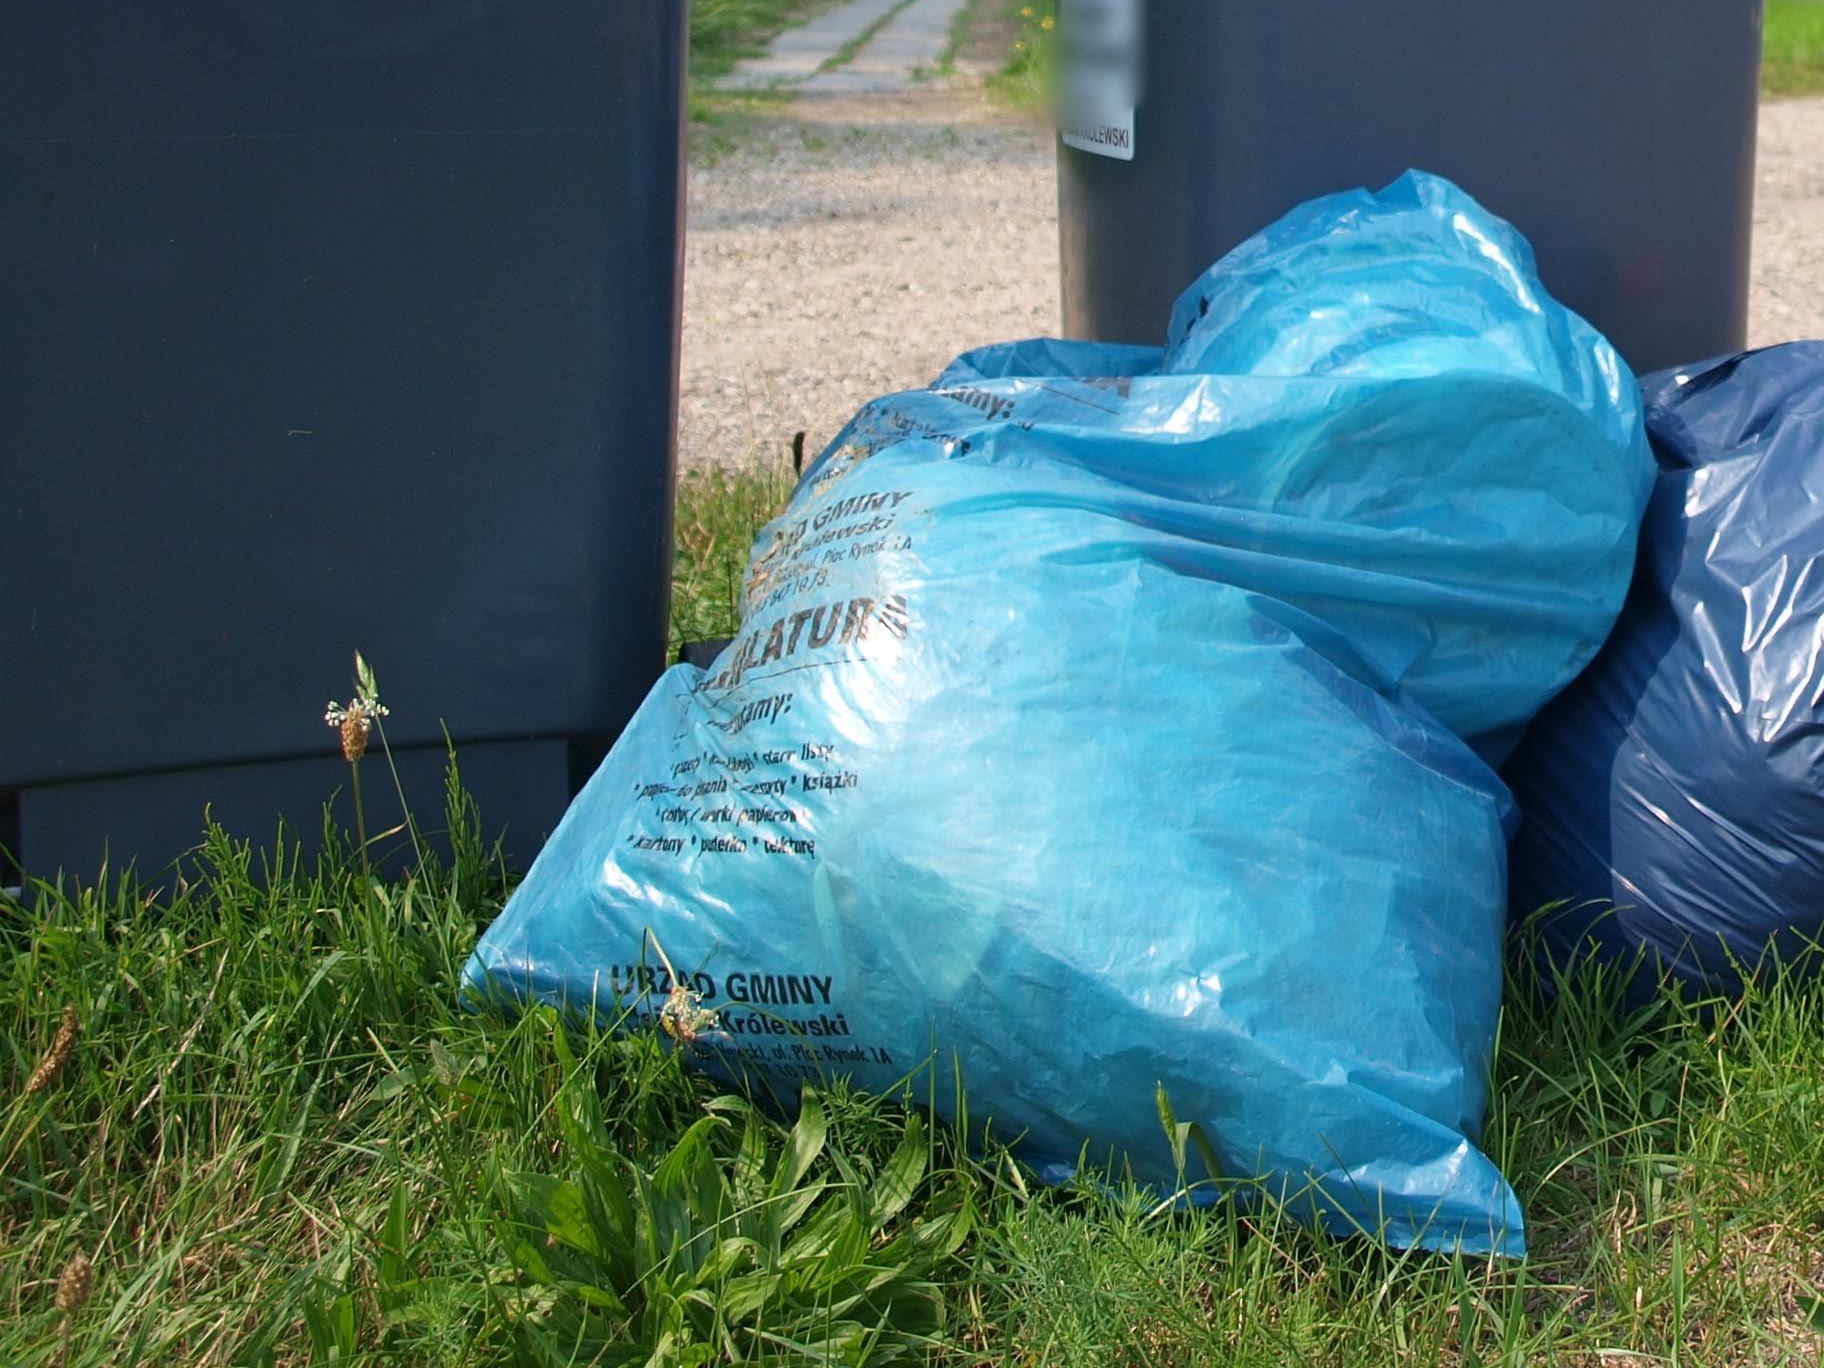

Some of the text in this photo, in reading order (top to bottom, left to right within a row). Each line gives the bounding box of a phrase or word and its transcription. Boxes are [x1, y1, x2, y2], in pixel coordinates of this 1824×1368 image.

[1078, 125, 1129, 148] LEWSKI
[812, 491, 914, 531] GMINY
[803, 770, 858, 795] książki
[634, 834, 686, 856] kartony
[725, 972, 833, 1005] GMINY
[719, 1010, 850, 1036] Królewski
[823, 1043, 870, 1068] Rynek
